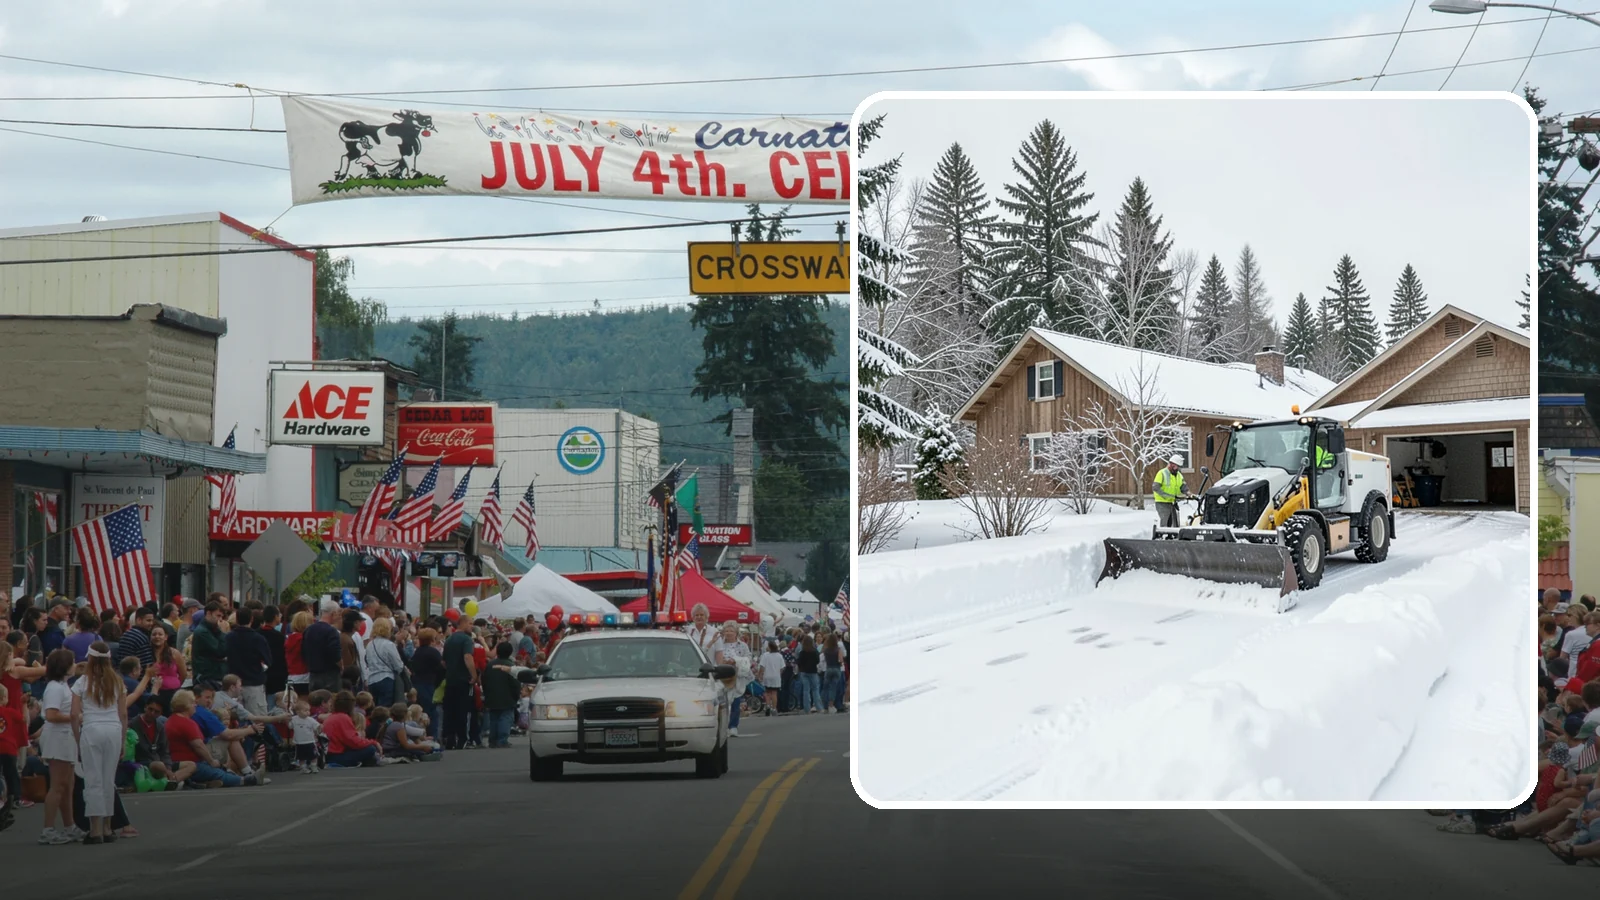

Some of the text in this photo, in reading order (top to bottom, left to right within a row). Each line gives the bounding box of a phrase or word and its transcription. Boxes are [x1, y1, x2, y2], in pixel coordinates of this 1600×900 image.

[695, 121, 850, 150] Carnat
[481, 141, 605, 192] JULY
[632, 150, 747, 198] 4th.
[697, 254, 850, 280] CROSSWA
[282, 379, 373, 420] ACE
[405, 409, 485, 422] CEDAR LOG
[283, 421, 371, 437] Hardware
[416, 428, 477, 447] Coca-Cola
[354, 467, 386, 480] Simpl
[83, 485, 155, 495] St. Vincent de Paul
[81, 503, 153, 522] THT
[212, 516, 331, 536] HARDARE
[688, 526, 742, 535] CRNATION
[699, 535, 730, 544] GLASS
